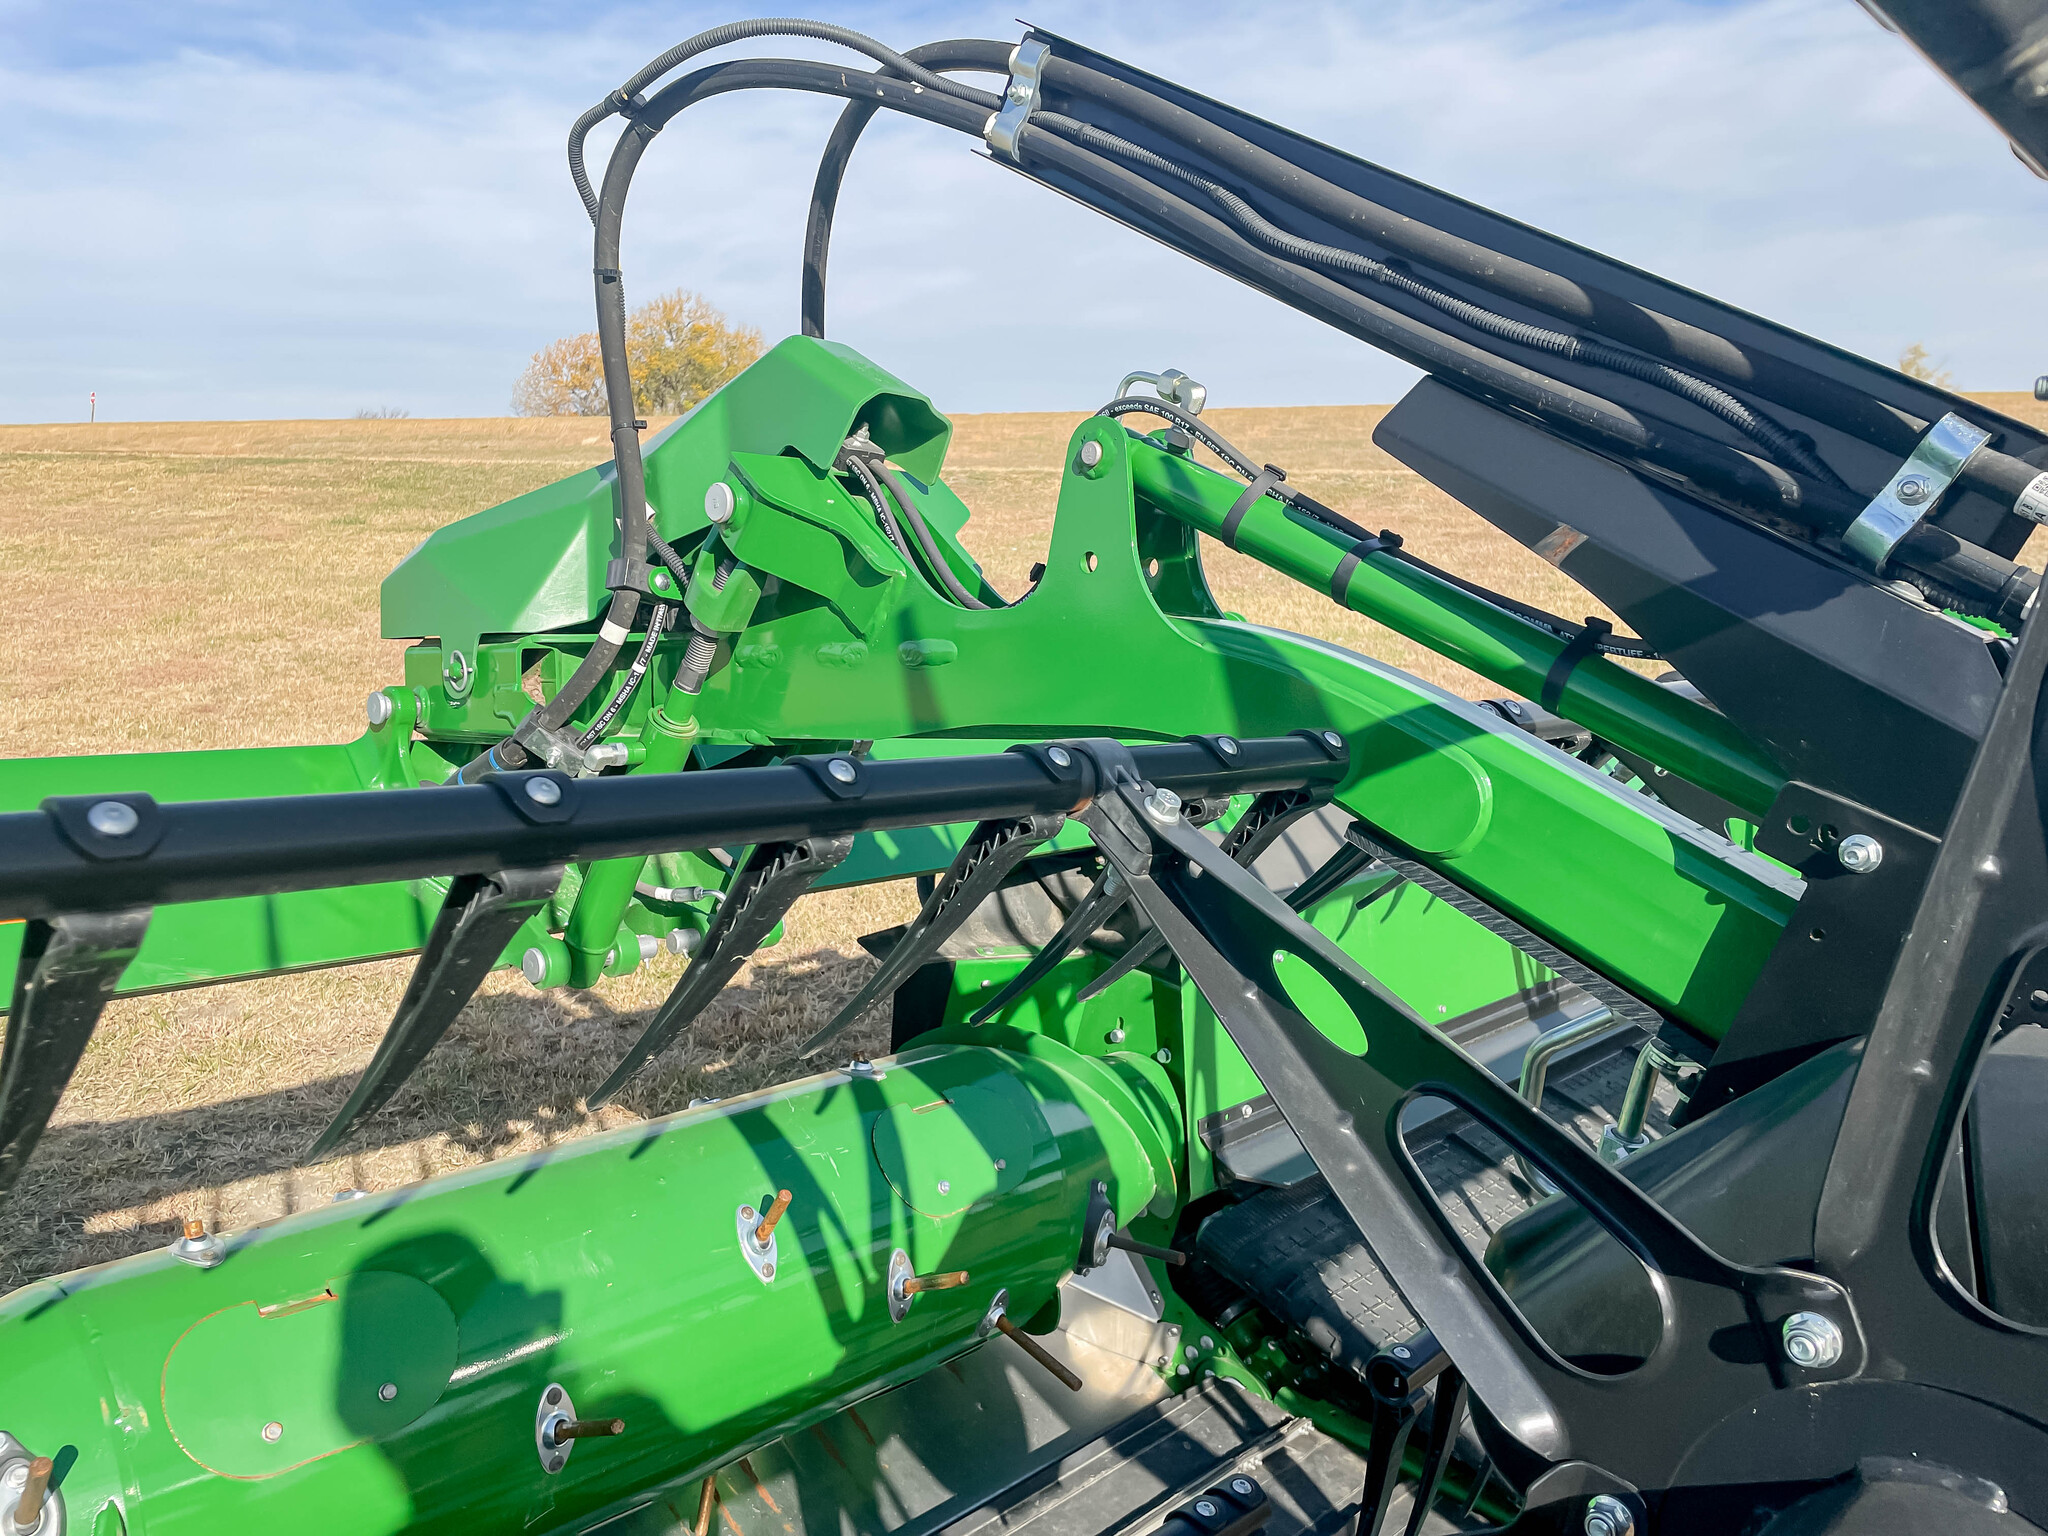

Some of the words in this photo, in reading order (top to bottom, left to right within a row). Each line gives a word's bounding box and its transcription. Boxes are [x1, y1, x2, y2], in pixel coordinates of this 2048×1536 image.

[1114, 403, 1143, 413] exceeds
[1144, 404, 1160, 413] SAE
[1161, 410, 1174, 420] 100
[870, 492, 881, 513] MSHA
[1266, 488, 1283, 501] SHA
[1595, 643, 1644, 658] PERTUFF
[594, 720, 606, 731] 1SC
[602, 711, 614, 722] DN
[616, 685, 632, 705] MSHA
[645, 631, 658, 654] MADE
[653, 622, 661, 632] IN
